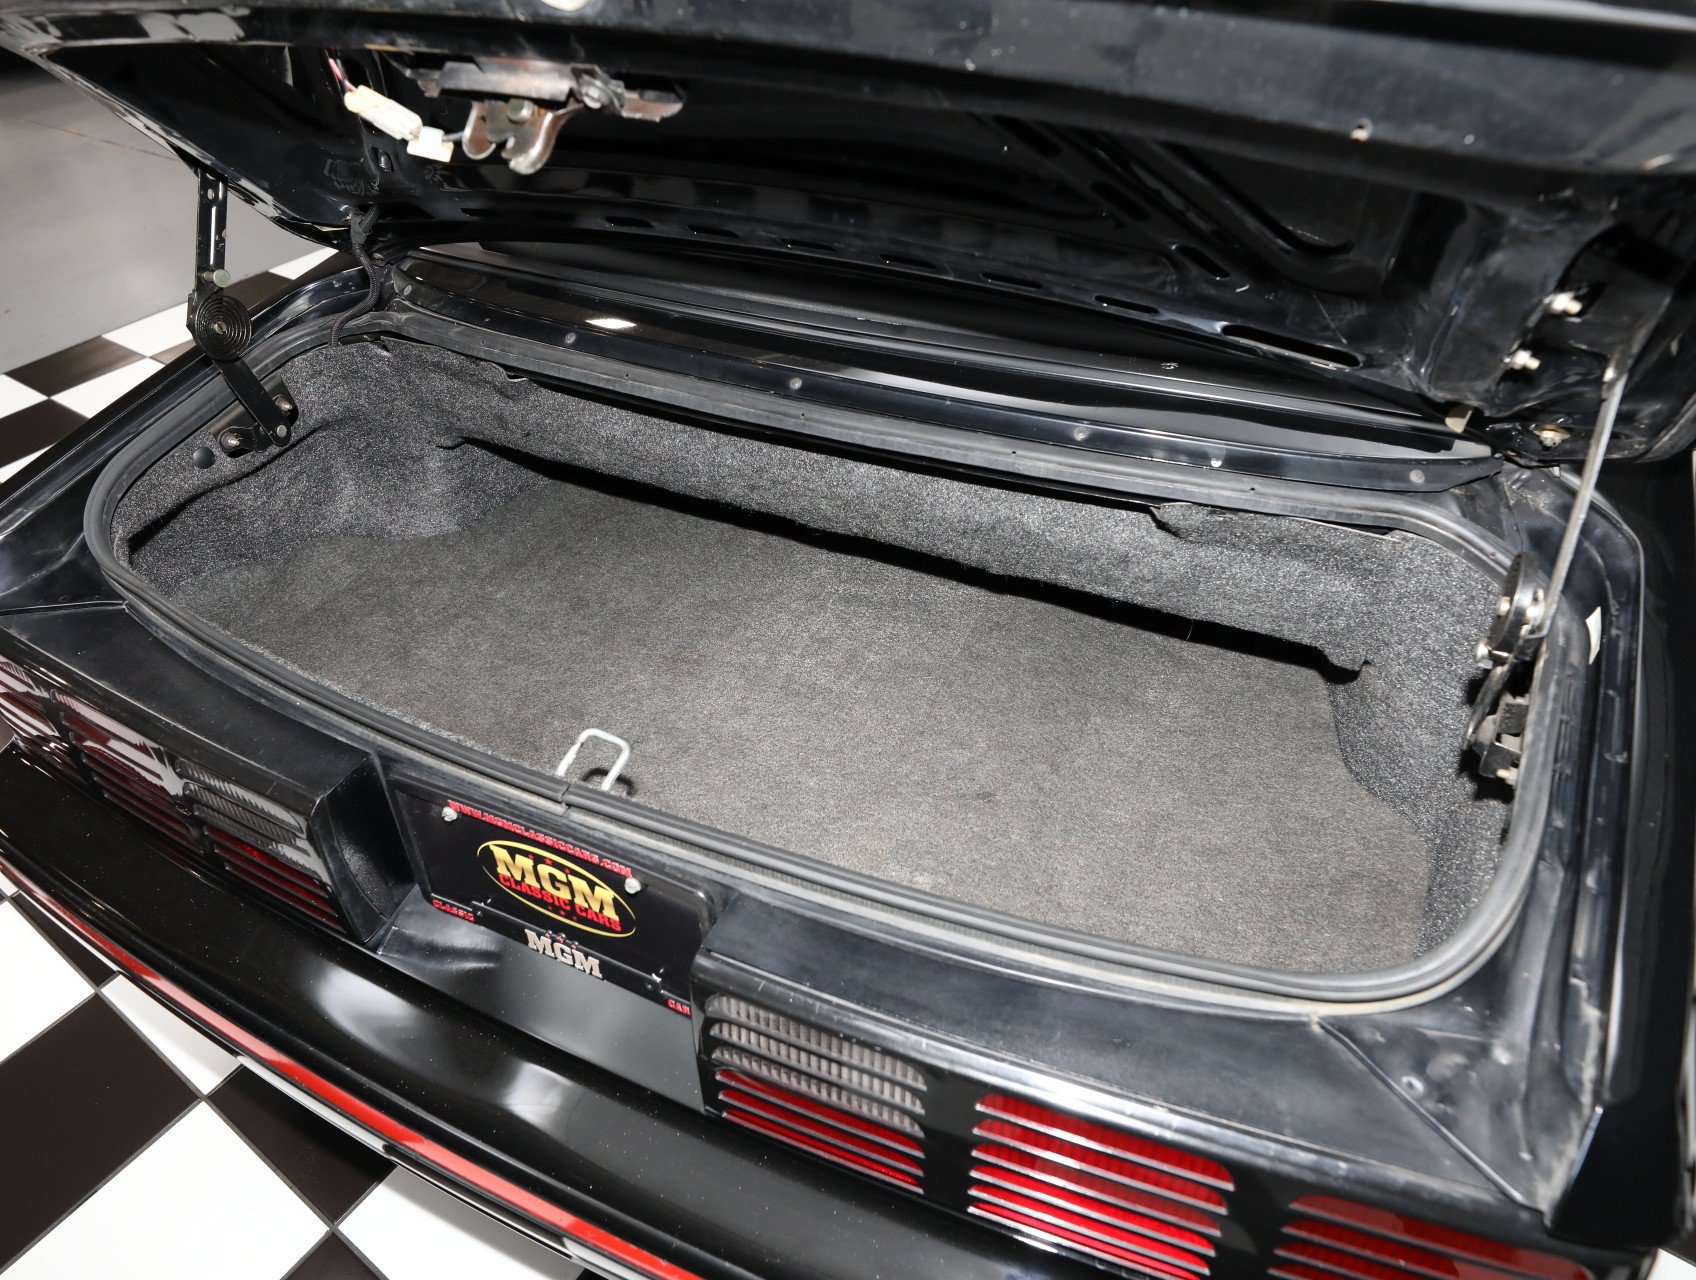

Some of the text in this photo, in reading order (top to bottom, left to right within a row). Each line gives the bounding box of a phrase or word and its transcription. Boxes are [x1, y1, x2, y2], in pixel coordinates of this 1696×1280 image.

[489, 844, 620, 921] MGM
[498, 873, 622, 931] CLASSIC CARS
[432, 899, 474, 922] CLASSIC
[525, 929, 602, 978] MGM
